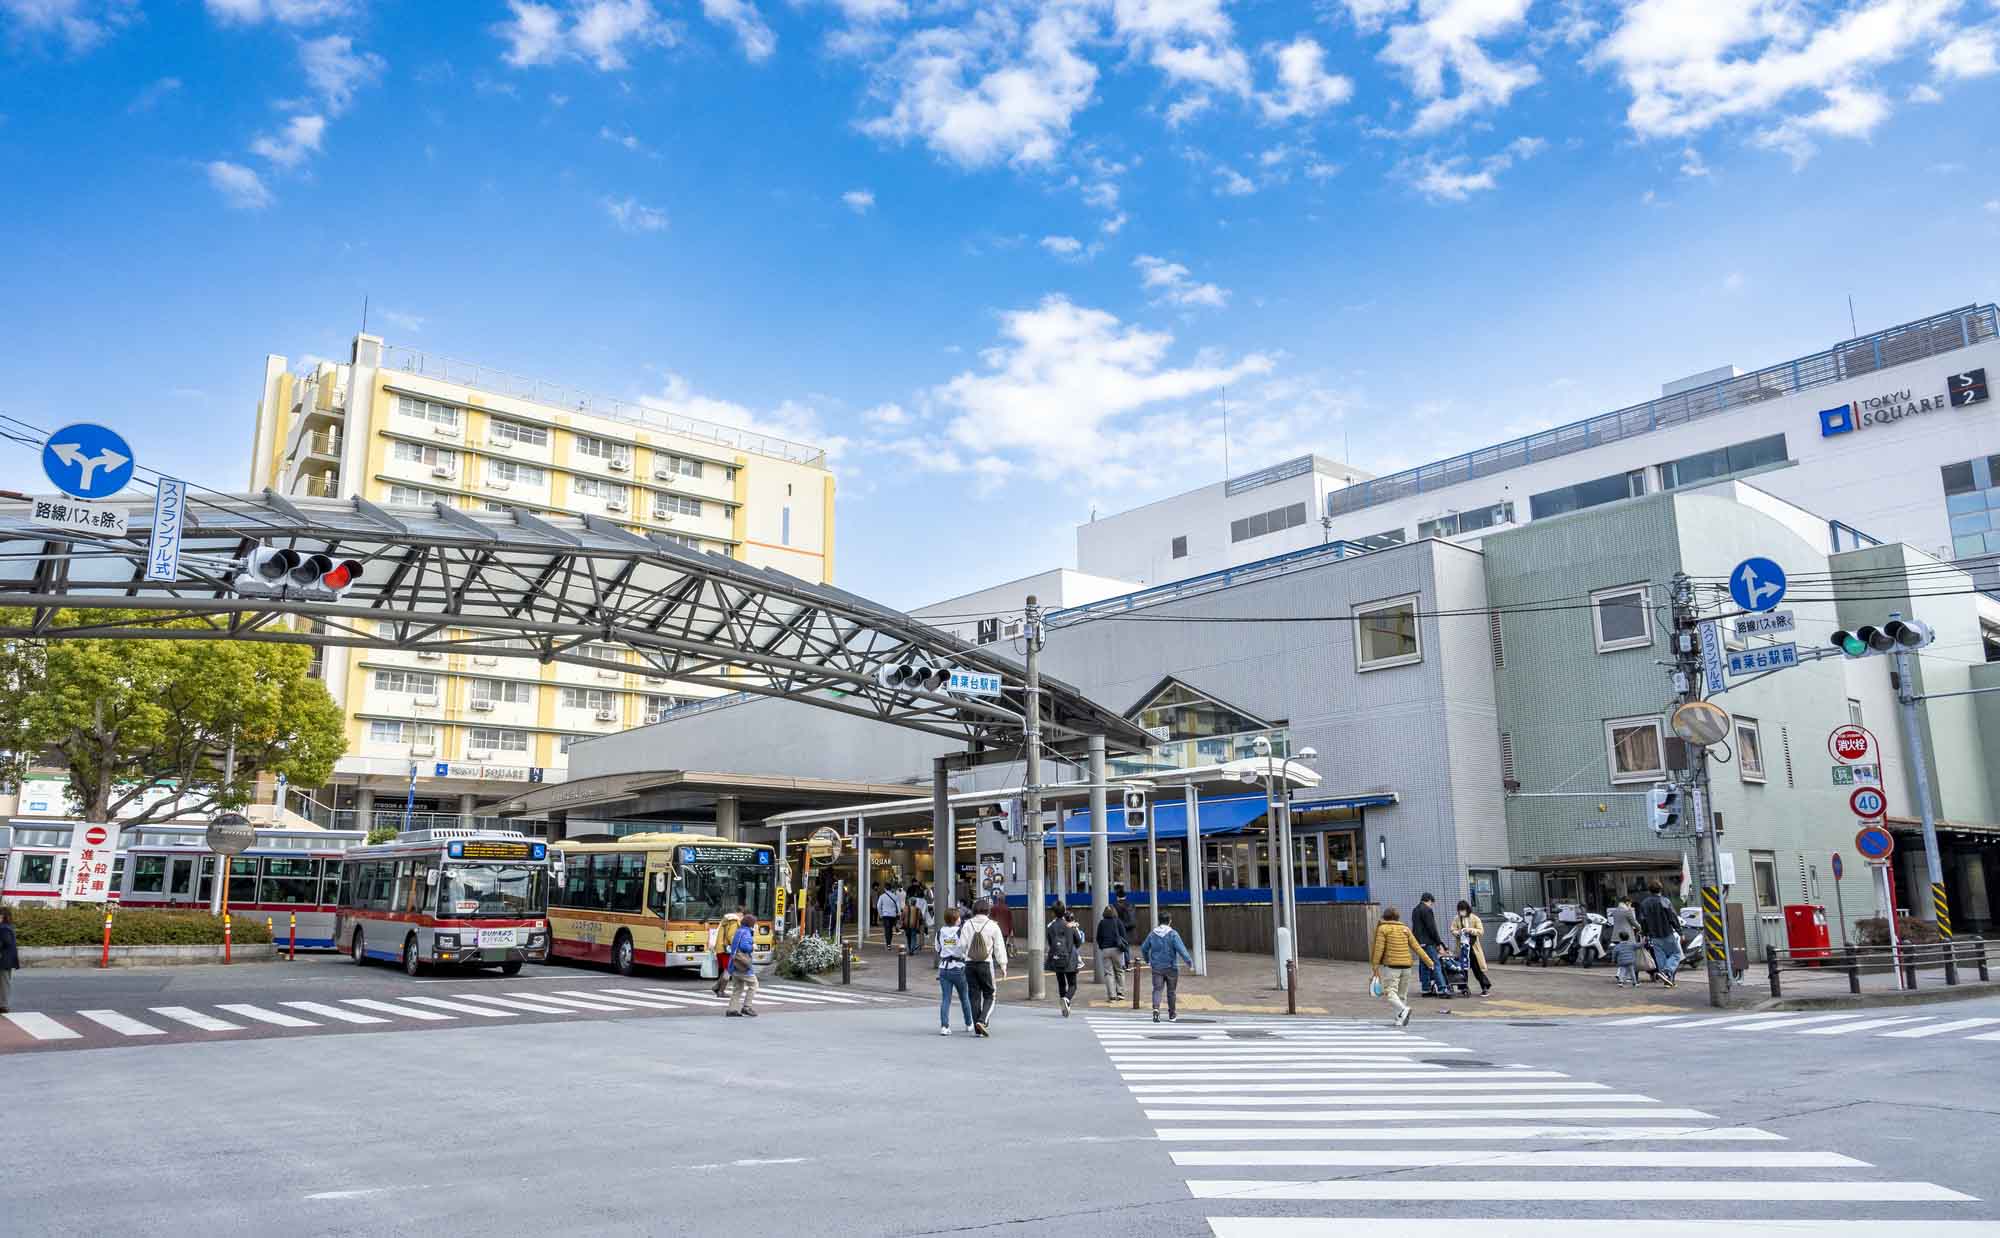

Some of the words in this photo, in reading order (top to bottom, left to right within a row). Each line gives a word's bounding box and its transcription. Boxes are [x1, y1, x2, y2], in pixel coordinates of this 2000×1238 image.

[1959, 373, 1974, 387] S
[1862, 389, 1912, 410] TOKYU
[1962, 390, 1976, 405] 2
[1863, 394, 1945, 427] SQUARE
[35, 501, 124, 531] 路線バスを除く
[155, 482, 178, 576] スクランブル式
[983, 619, 992, 634] N
[1736, 615, 1793, 634] 路線バスを除く
[1703, 624, 1722, 690] スクランブル式
[1731, 647, 1794, 672] 青葉台駅前
[951, 674, 998, 692] 青葉台駅前
[1837, 738, 1866, 752] 消火栓
[485, 768, 525, 778] SQUARE
[1858, 795, 1879, 810] 40
[75, 848, 94, 896] 進入禁止
[91, 850, 112, 891] 一般車
